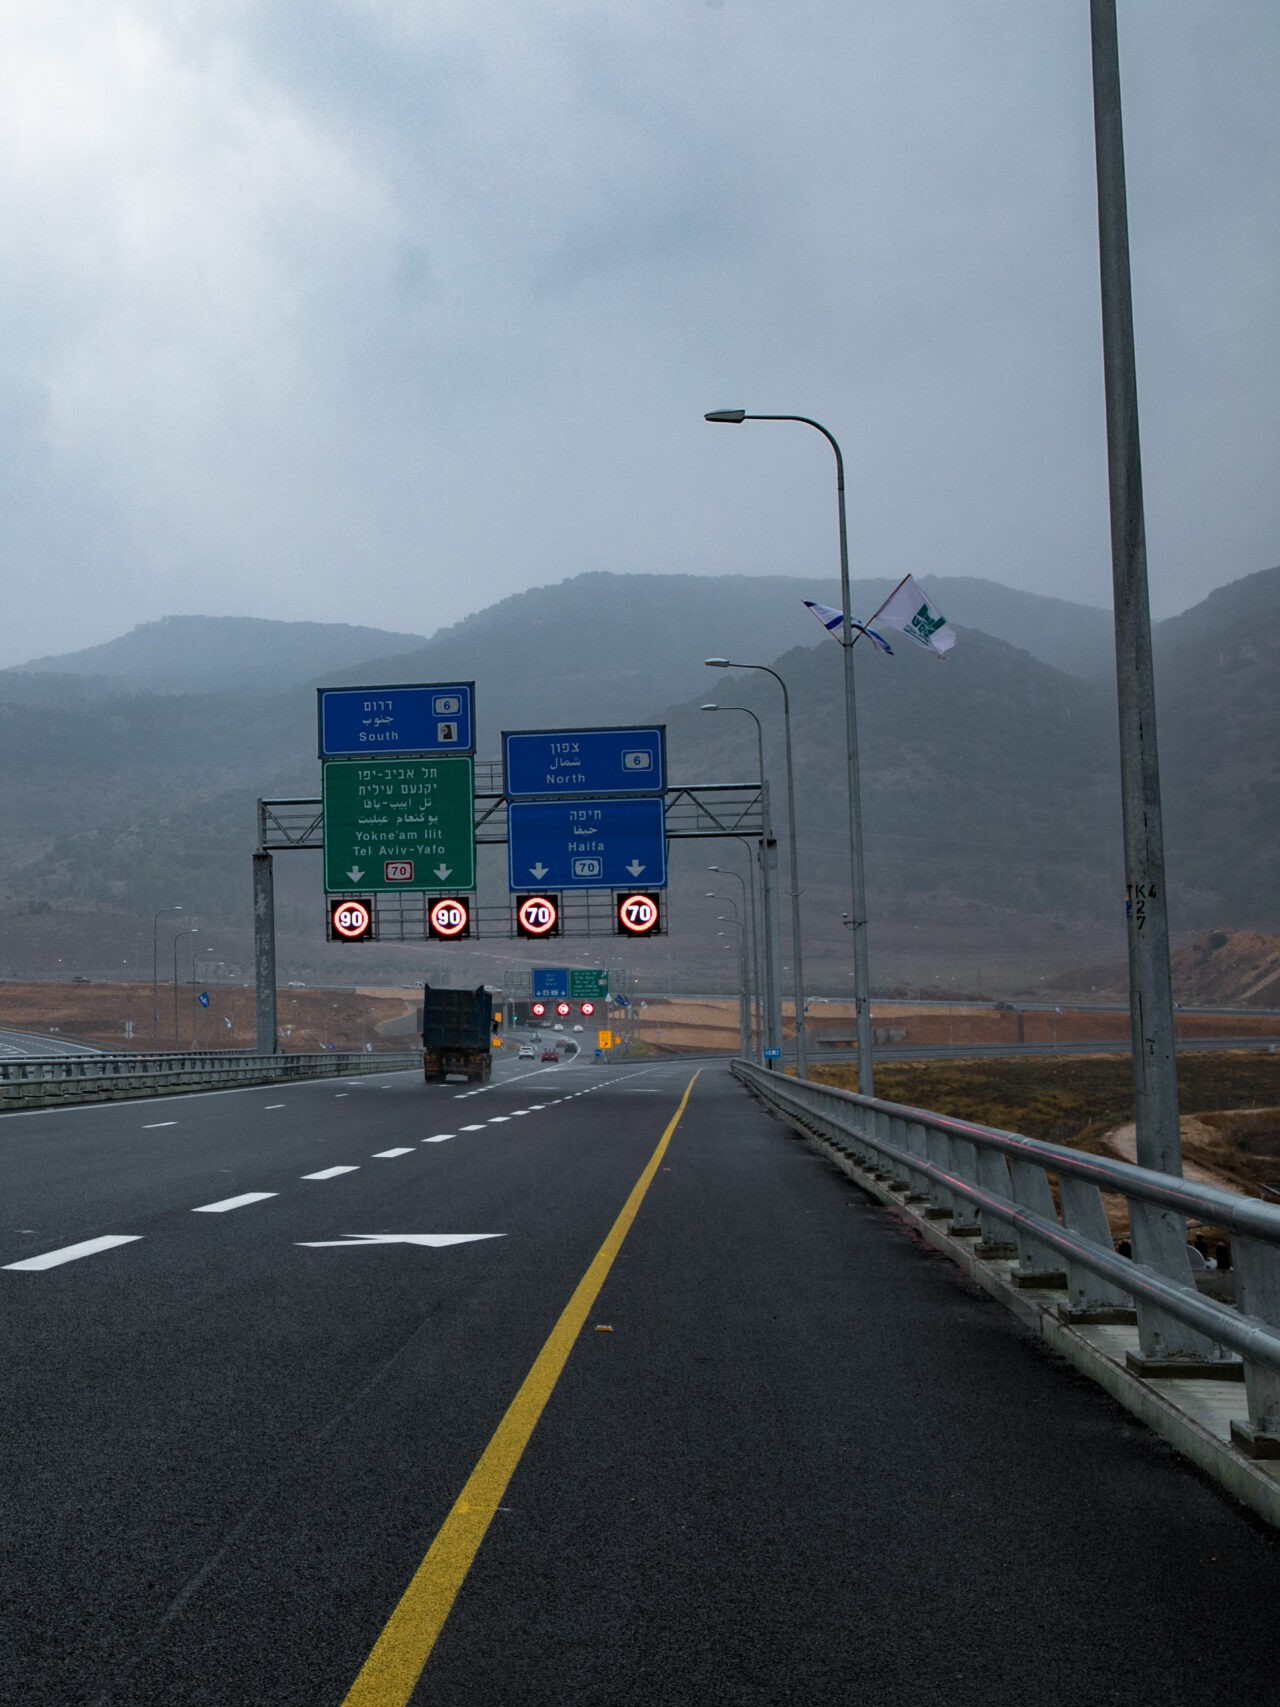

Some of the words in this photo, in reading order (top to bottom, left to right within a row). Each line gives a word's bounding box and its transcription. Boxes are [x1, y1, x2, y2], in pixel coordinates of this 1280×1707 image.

[363, 700, 393, 712] דרום
[443, 701, 451, 711] 6
[362, 715, 394, 727] جنوب
[359, 731, 399, 742] South
[550, 741, 580, 755] צפון
[549, 756, 582, 770] شمال
[633, 755, 641, 766] 6
[357, 769, 415, 781] אביב-יפו
[421, 767, 438, 779] תל
[546, 773, 586, 784] North
[358, 784, 394, 796] עילית
[401, 783, 437, 795] יקנעם
[418, 797, 433, 811] تل
[569, 809, 602, 821] חיפה
[355, 830, 418, 841] Yokne'am
[424, 828, 443, 840] Ilit
[573, 824, 598, 837] حيفا
[353, 846, 372, 857] Tel
[379, 844, 445, 856] Aviv-Yafo
[568, 841, 605, 852] Haifa
[391, 866, 407, 876] 70
[579, 862, 595, 872] 70
[340, 911, 363, 927] 90
[437, 909, 461, 926] 90
[527, 907, 549, 924] 70
[627, 905, 651, 922] 70
